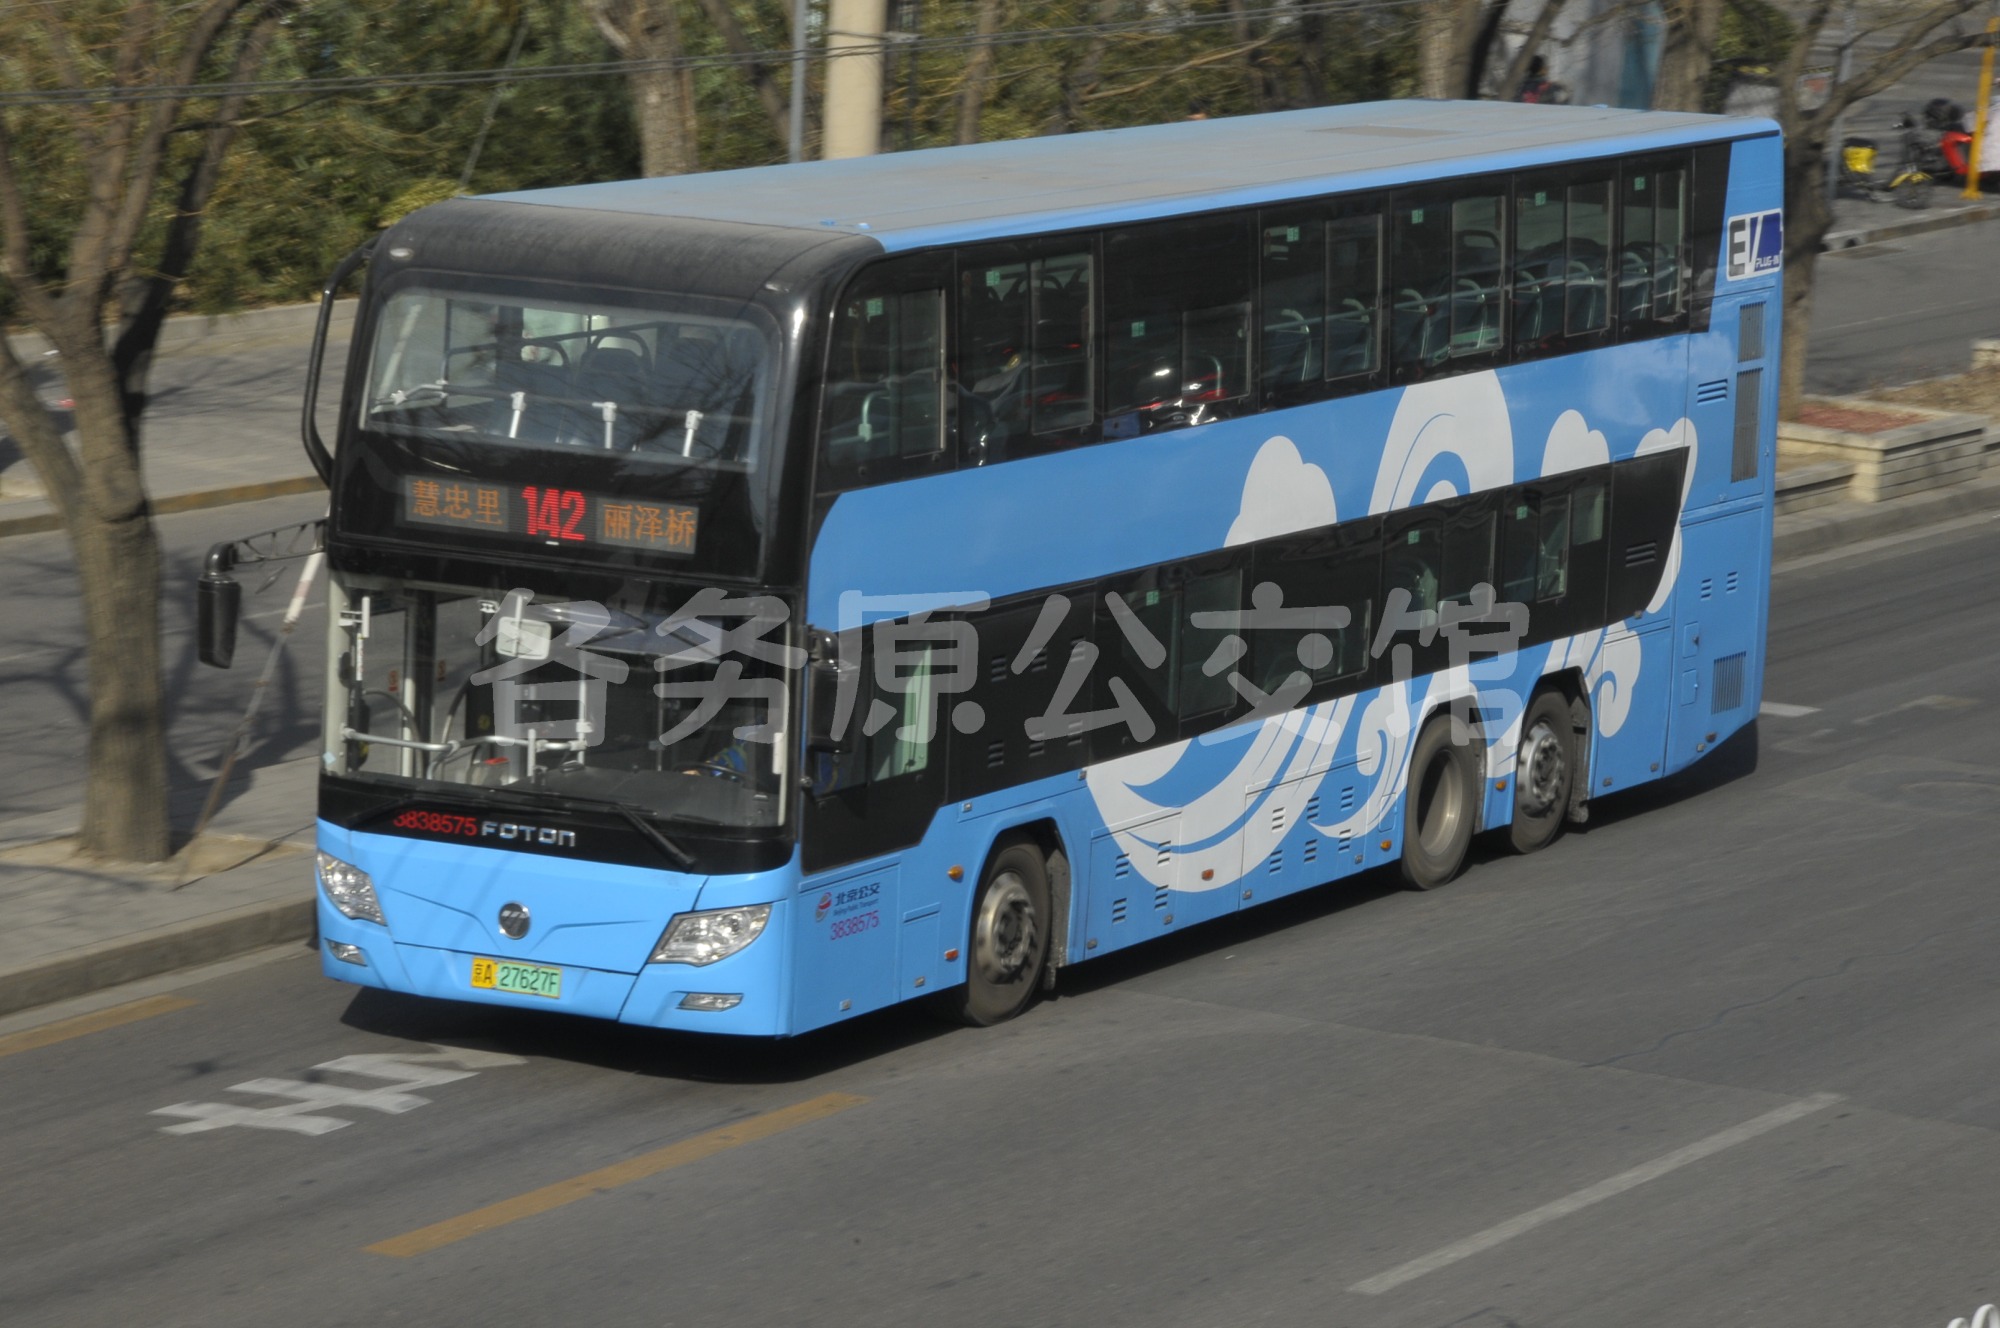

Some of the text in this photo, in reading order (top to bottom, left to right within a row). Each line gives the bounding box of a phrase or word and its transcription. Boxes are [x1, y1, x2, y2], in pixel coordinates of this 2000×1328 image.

[1729, 215, 1763, 277] EV
[412, 479, 696, 547] 慧忠里 142 丽泽桥
[393, 811, 575, 847] 3838575 FOTON
[834, 883, 881, 906] 北京公交
[830, 909, 880, 941] 3838575
